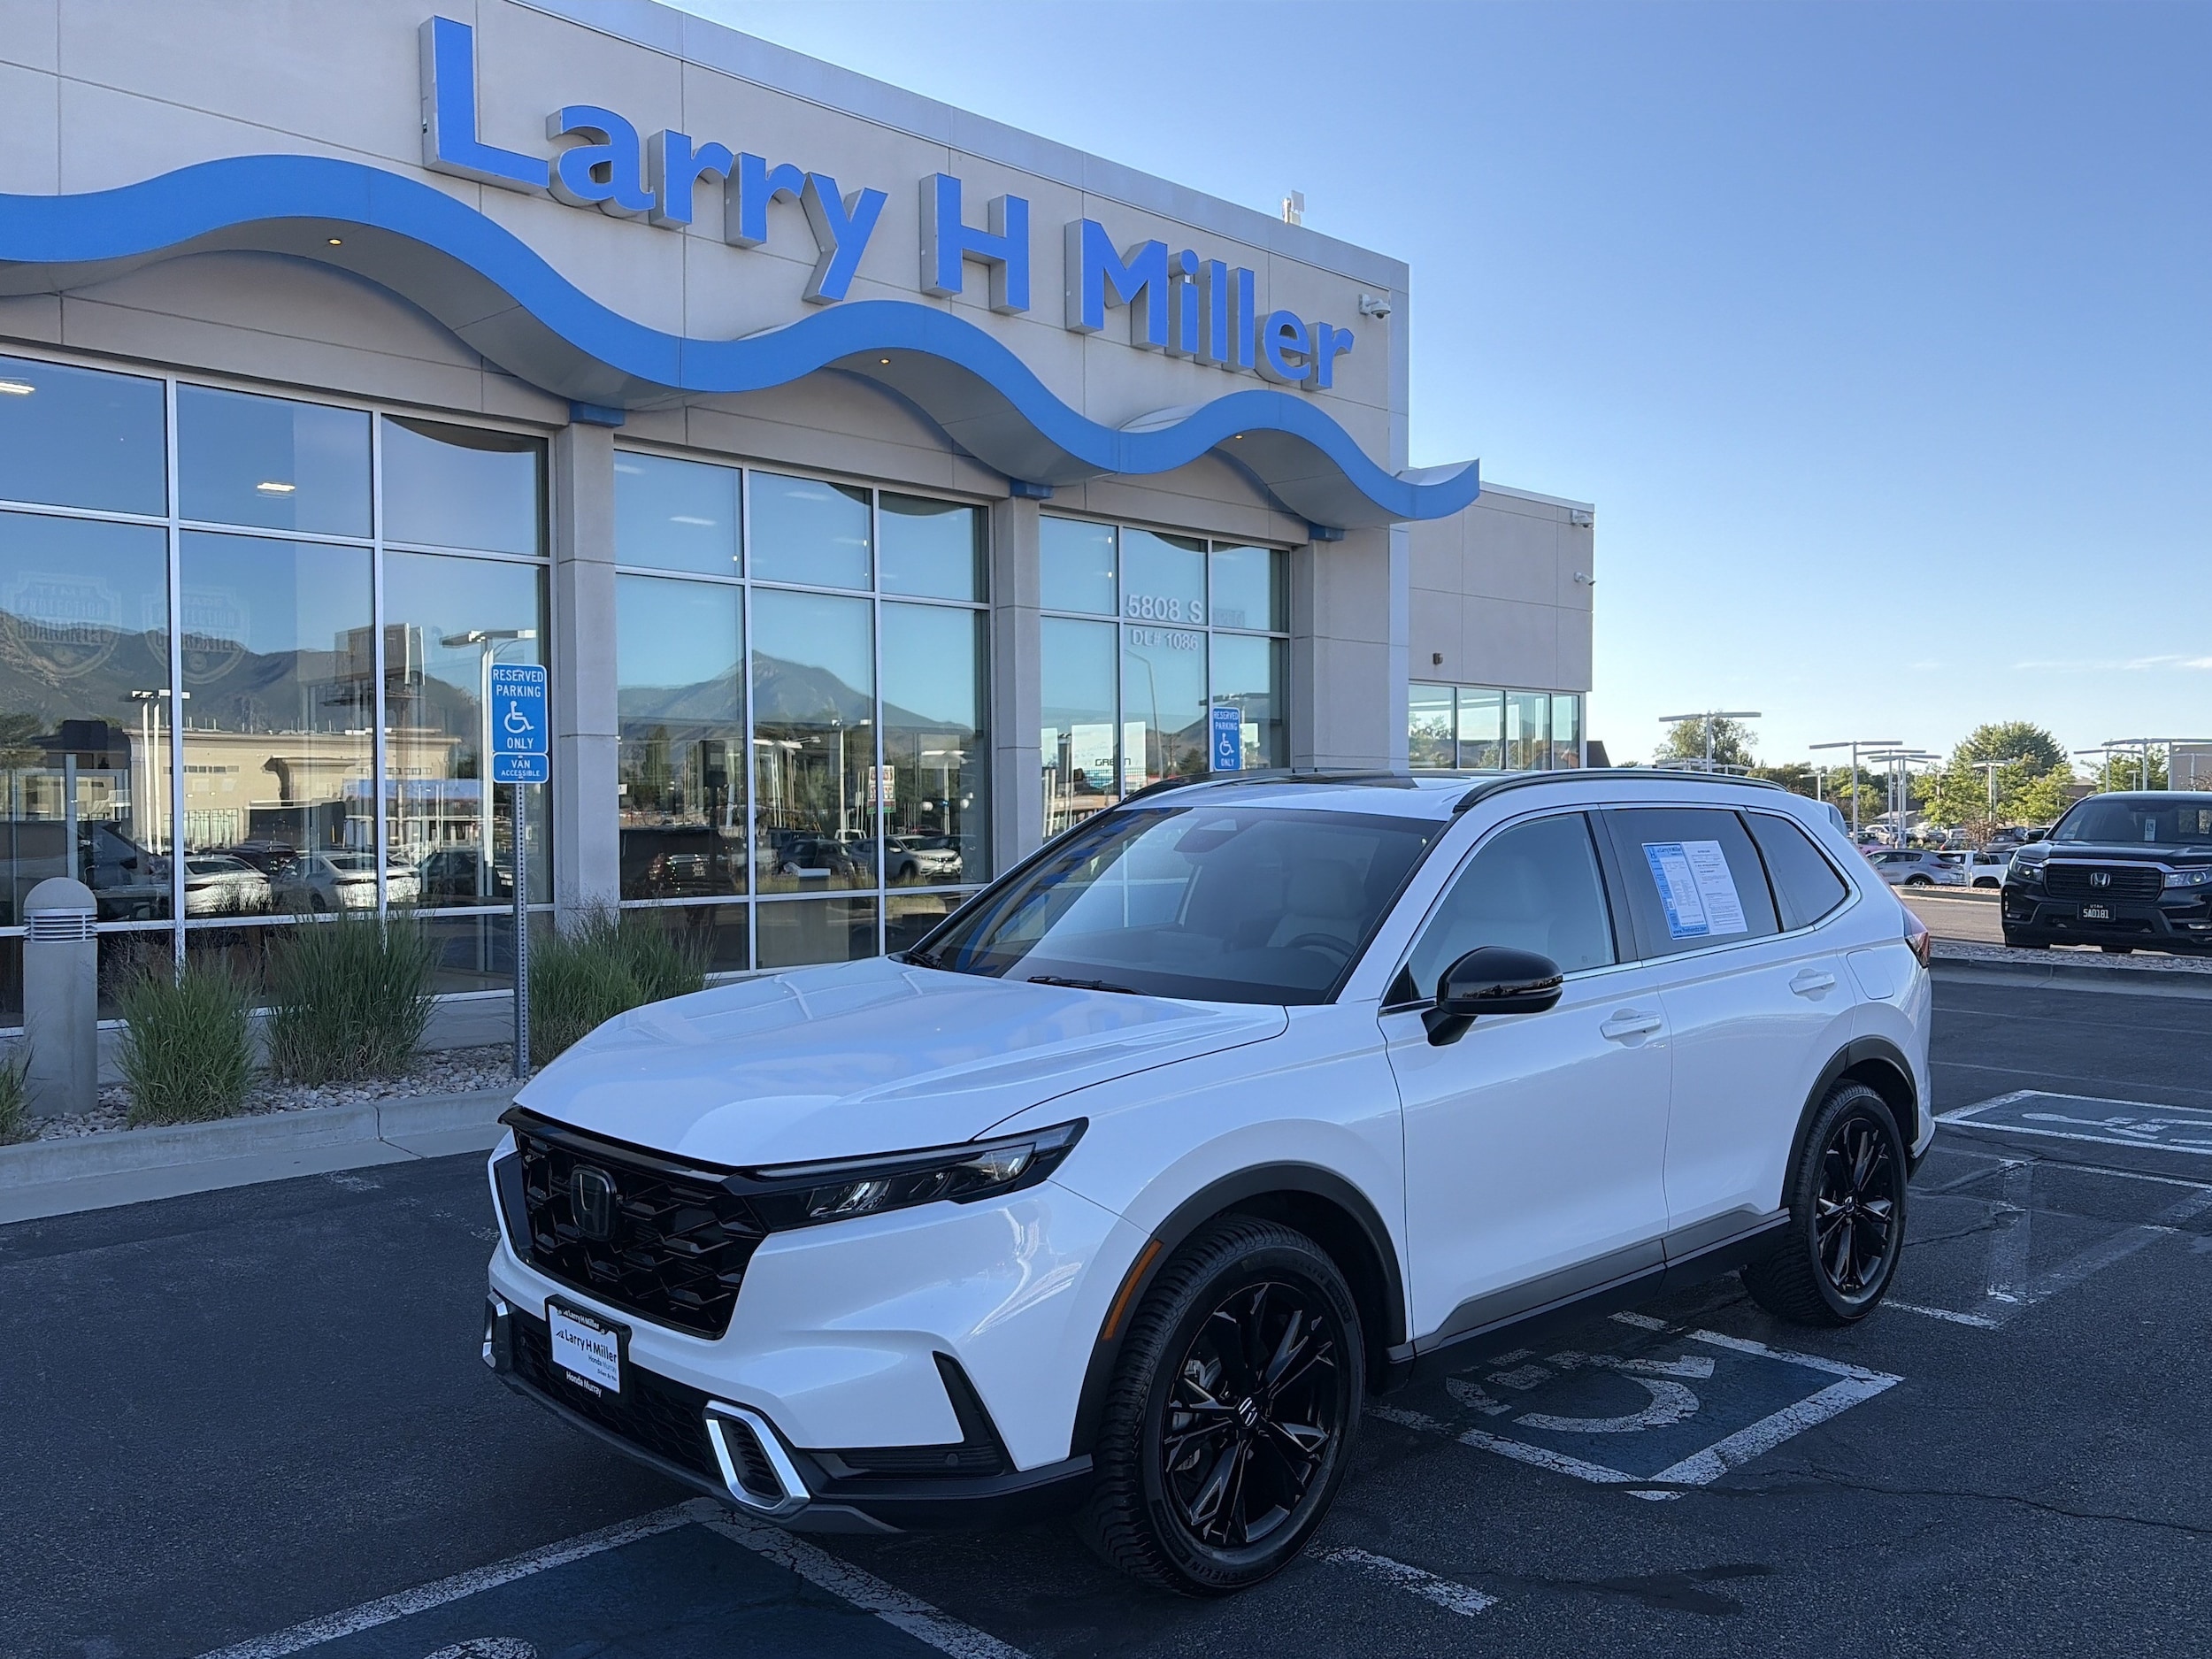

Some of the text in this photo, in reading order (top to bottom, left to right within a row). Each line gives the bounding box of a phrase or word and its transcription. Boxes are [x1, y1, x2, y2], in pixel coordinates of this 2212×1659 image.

[421, 15, 1355, 391] Larry H Miller
[1127, 595, 1180, 620] 5808
[1189, 600, 1203, 624] S
[1133, 629, 1198, 650] DL# 1086
[493, 669, 543, 682] RESERVED
[496, 685, 541, 697] PARKING
[1213, 711, 1238, 720] RESERVED
[1215, 722, 1238, 731] PARKING
[506, 737, 534, 749] ONLY
[511, 760, 530, 769] VAN
[565, 1329, 617, 1363] Larry H Miller
[588, 1355, 602, 1367] Honda
[566, 1371, 603, 1398] Honda Murray
